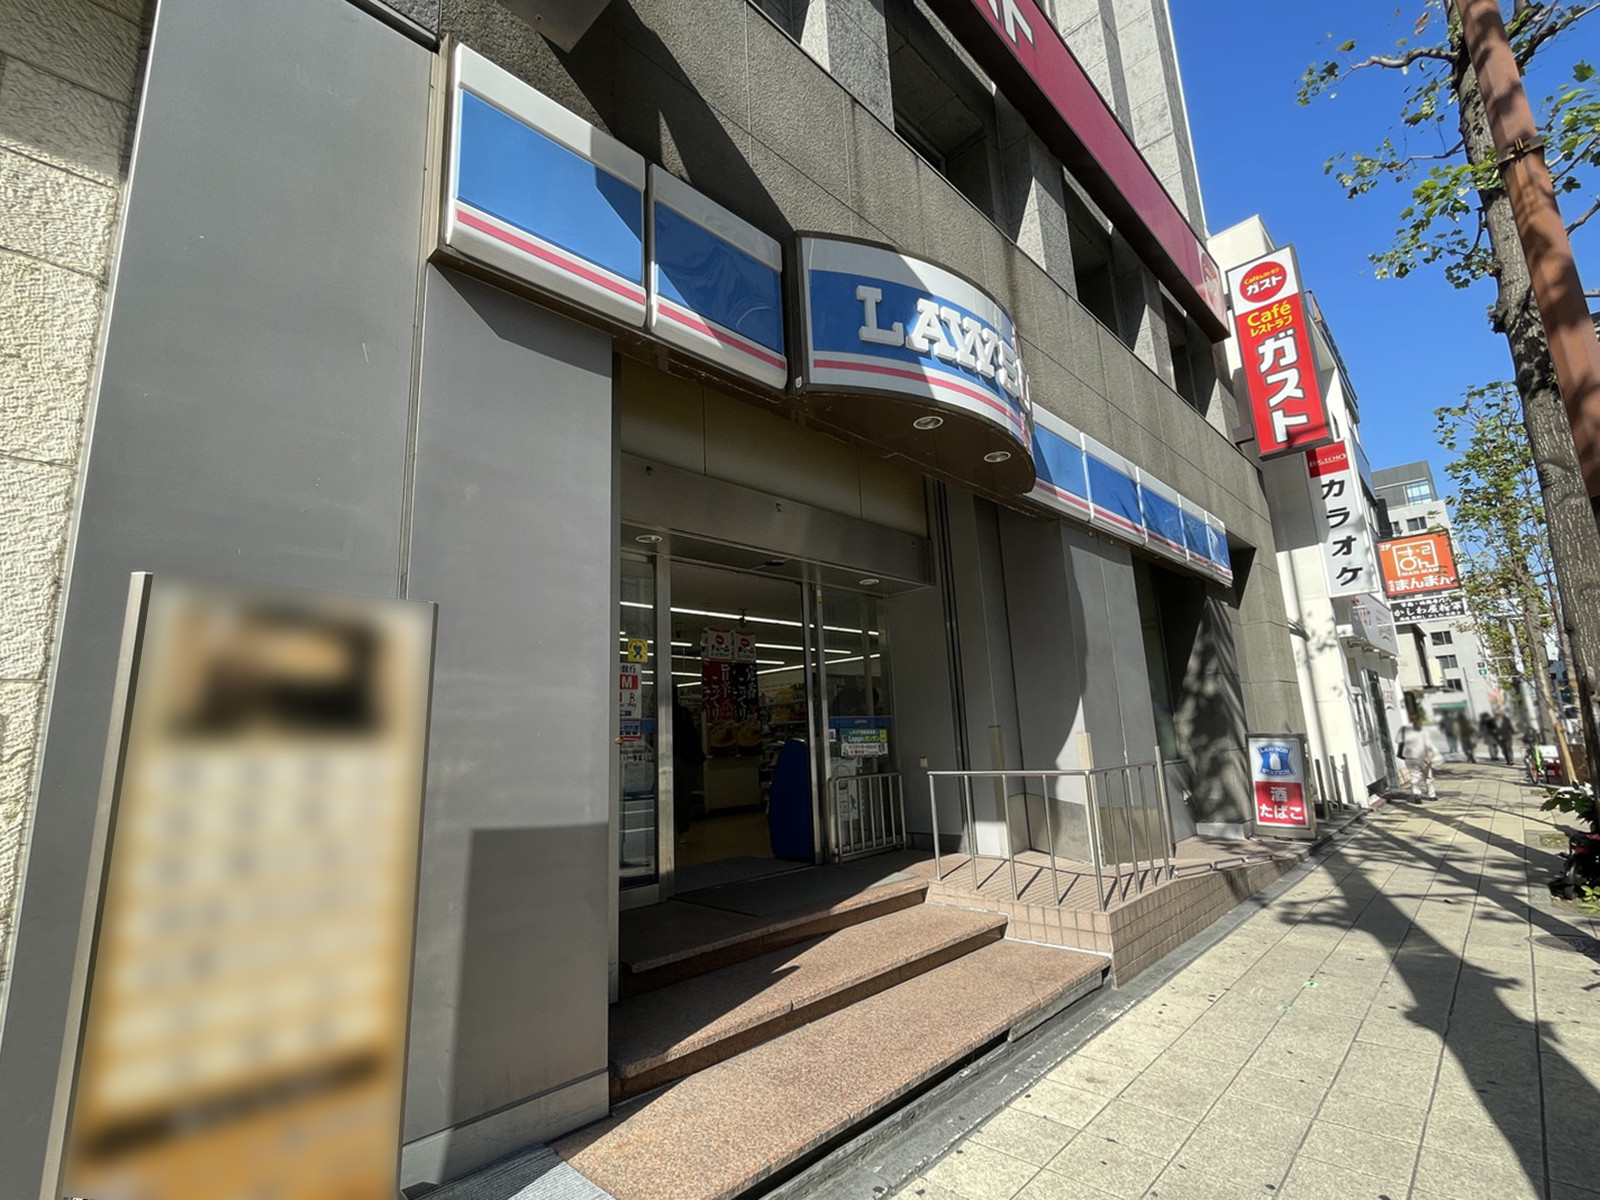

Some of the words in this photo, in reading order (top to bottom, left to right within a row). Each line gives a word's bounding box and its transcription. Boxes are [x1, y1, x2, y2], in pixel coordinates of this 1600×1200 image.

[1246, 275, 1283, 297] ガスト
[1247, 301, 1292, 327] Café
[1250, 315, 1293, 337] レストラン
[1257, 328, 1310, 445] ガスト
[1321, 478, 1363, 586] カラオケ
[1260, 746, 1290, 754] LAWSON
[1261, 768, 1293, 776] STATION
[1270, 786, 1288, 803] 酒
[1259, 803, 1304, 821] たばこ
